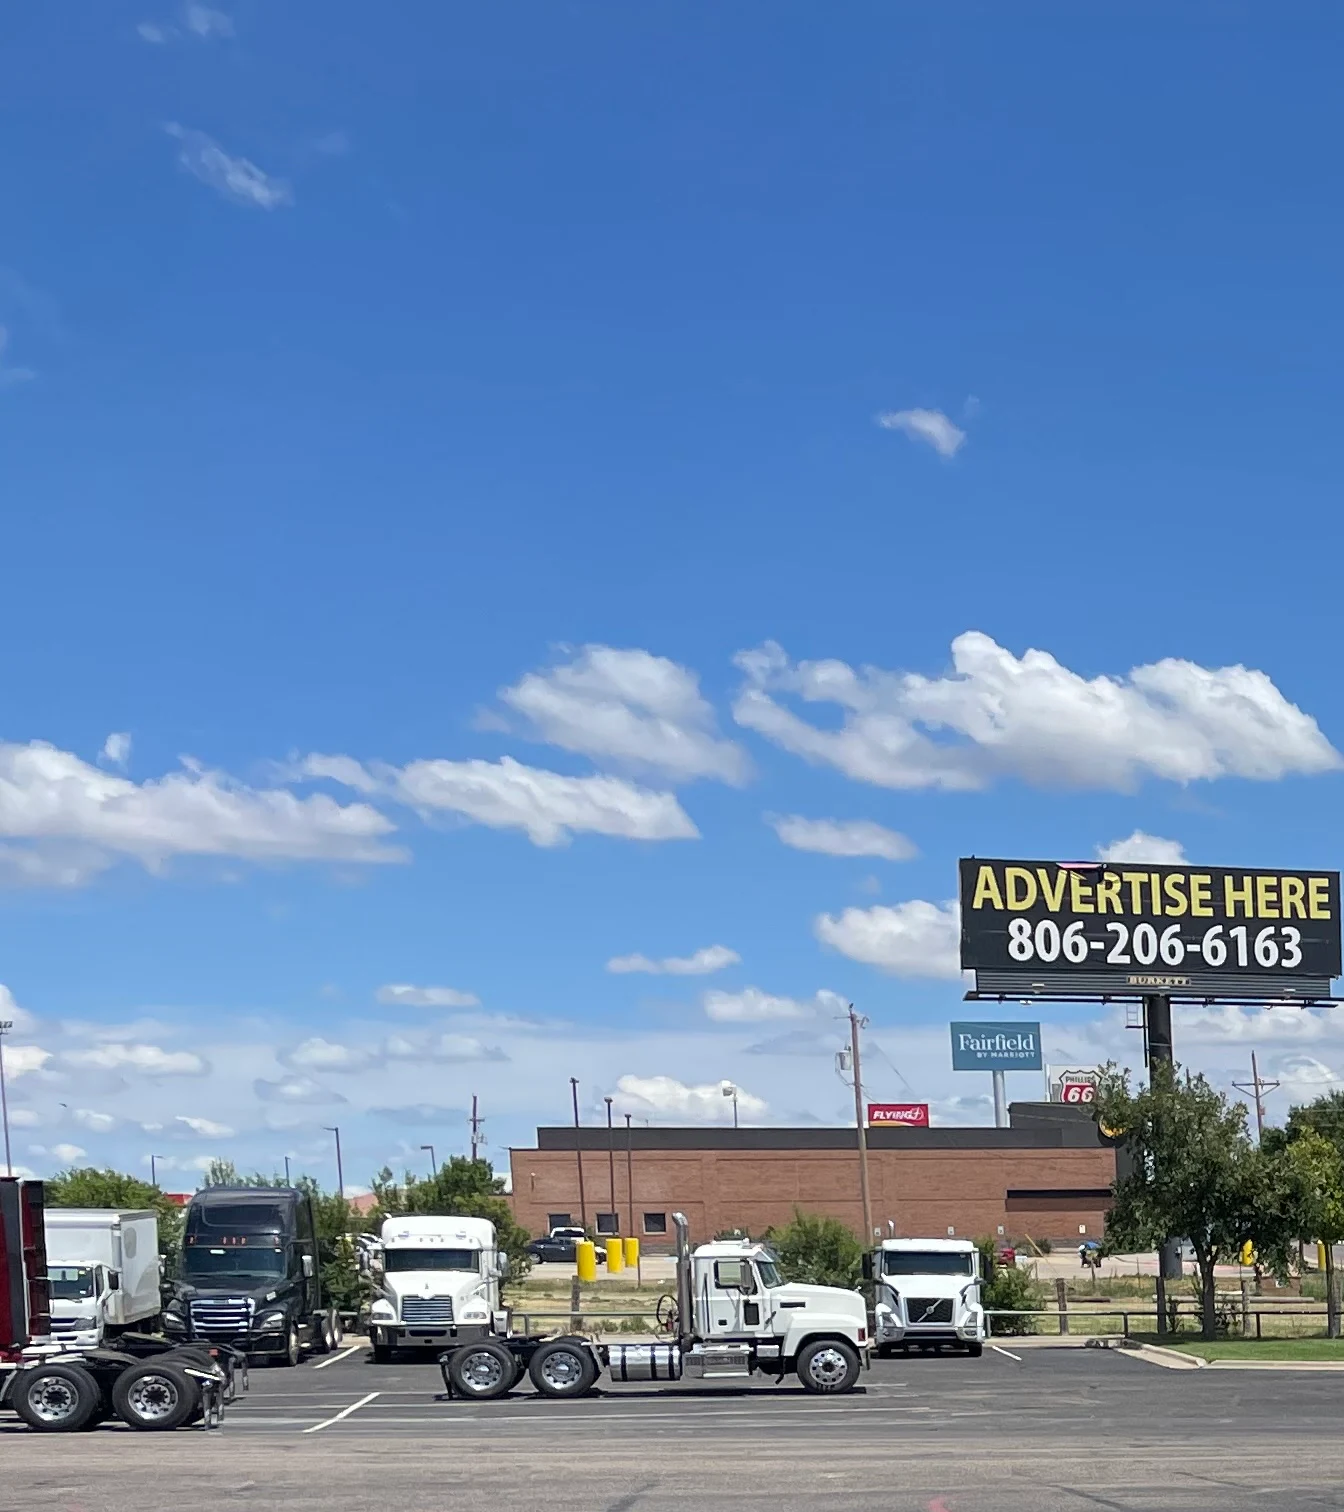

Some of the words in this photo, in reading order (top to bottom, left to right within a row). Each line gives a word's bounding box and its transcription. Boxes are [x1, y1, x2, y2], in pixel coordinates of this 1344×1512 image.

[972, 864, 1213, 917] ADVERTISE
[1225, 874, 1332, 920] HERE
[1007, 917, 1303, 968] 806-206-6163
[958, 1033, 1035, 1051] Fairfield
[1067, 1086, 1094, 1103] 66
